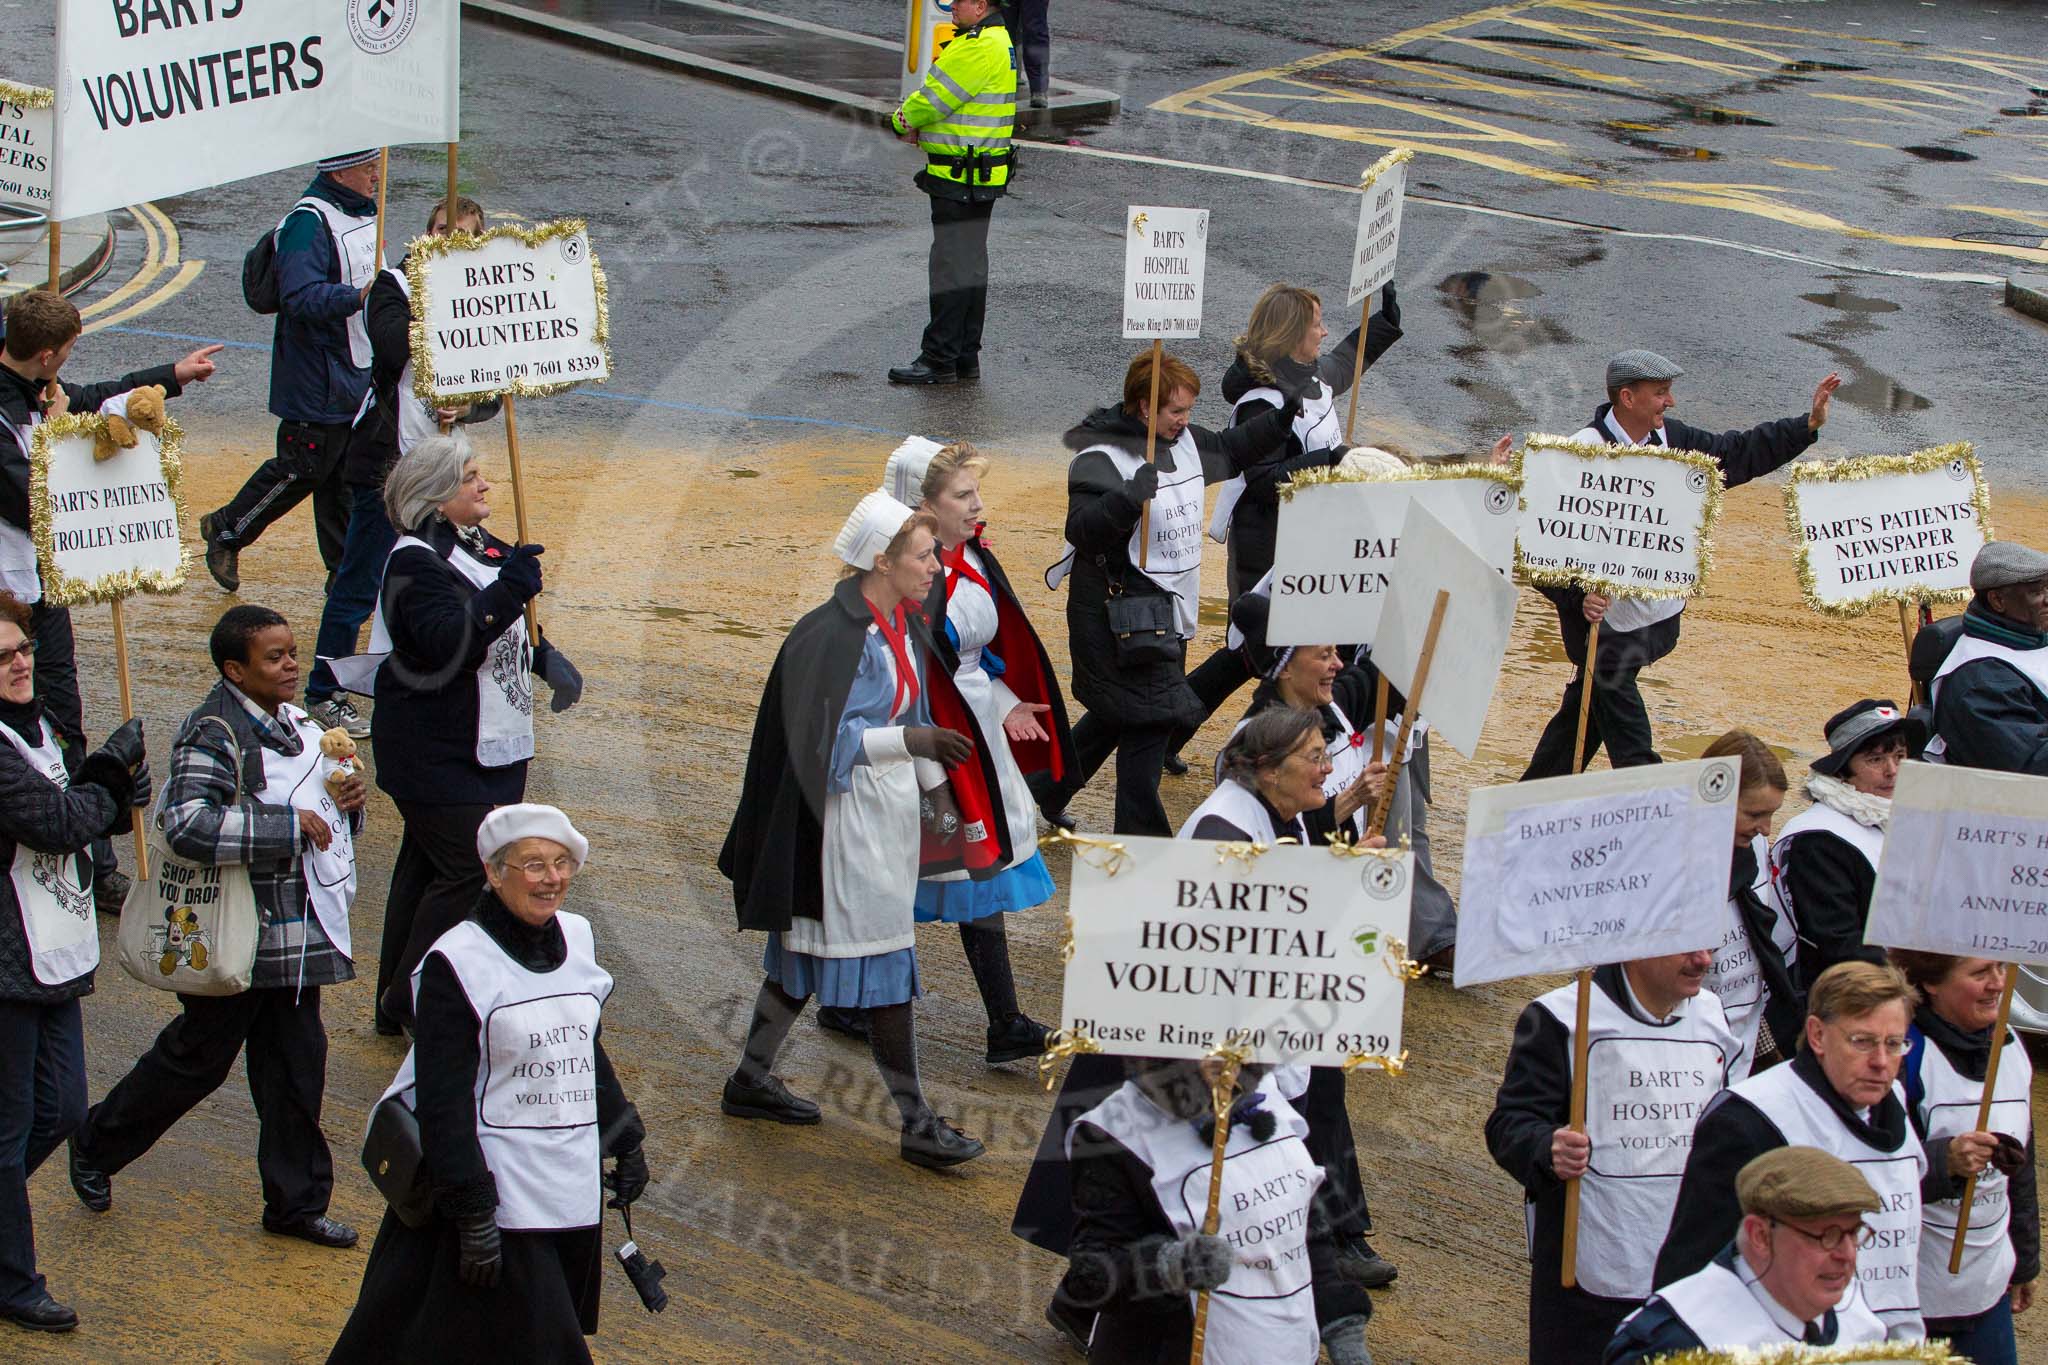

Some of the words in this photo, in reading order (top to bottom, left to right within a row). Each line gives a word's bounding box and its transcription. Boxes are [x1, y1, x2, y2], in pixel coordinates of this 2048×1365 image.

[82, 35, 324, 130] VOLUNTEERS
[1153, 230, 1185, 249] BART'S
[1367, 207, 1393, 240] HOSPITAL
[1360, 229, 1396, 266] VOLUNTEERS
[464, 262, 535, 288] BART'S
[1143, 256, 1190, 275] HOSPITAL
[451, 289, 557, 319] HOSPITAL
[1135, 282, 1196, 301] VOLUNTEERS
[437, 317, 579, 351] VOLUNTEERS
[1126, 319, 1146, 331] Please
[471, 368, 501, 384] Ring
[506, 363, 529, 380] 020
[533, 360, 562, 376] 7601
[568, 354, 600, 373] 8339
[1579, 471, 1656, 498] BART'S
[50, 488, 100, 514] BART'S
[1557, 494, 1669, 526] HOSPITAL
[53, 525, 114, 553] TROLLEY
[119, 518, 175, 545] SERVICE
[1537, 517, 1686, 554] VOLUNTEERS
[1806, 515, 1874, 542] BART'S
[1834, 527, 1955, 561] NEWSPAPER
[1564, 556, 1596, 574] Ring
[1601, 561, 1625, 576] 020
[1631, 564, 1658, 581] 7601
[1664, 570, 1696, 586] 8339
[1840, 550, 1960, 585] DELIVERIES
[1520, 816, 1582, 840] BART'S
[1591, 802, 1673, 829] HOSPITAL
[1957, 826, 2027, 848] BART'S
[1569, 837, 1623, 871] 885th
[162, 861, 196, 885] SHOP
[159, 879, 181, 903] YOU
[184, 886, 219, 905] DROP
[1176, 879, 1309, 915] BART'S
[1527, 872, 1652, 908] ANNIVERSARY
[1140, 920, 1337, 960] HOSPITAL
[1105, 961, 1367, 1004] VOLUNTEERS
[528, 1024, 589, 1050] BART'S
[1073, 1017, 1147, 1043] Please
[1159, 1023, 1215, 1048] Ring
[1226, 1027, 1266, 1050] 020
[1277, 1029, 1325, 1052] 7601
[1336, 1033, 1390, 1055] 8339
[1629, 1070, 1705, 1088] BART'S
[1233, 1168, 1308, 1213] BART'S
[1226, 1206, 1308, 1248] HOSPIT
